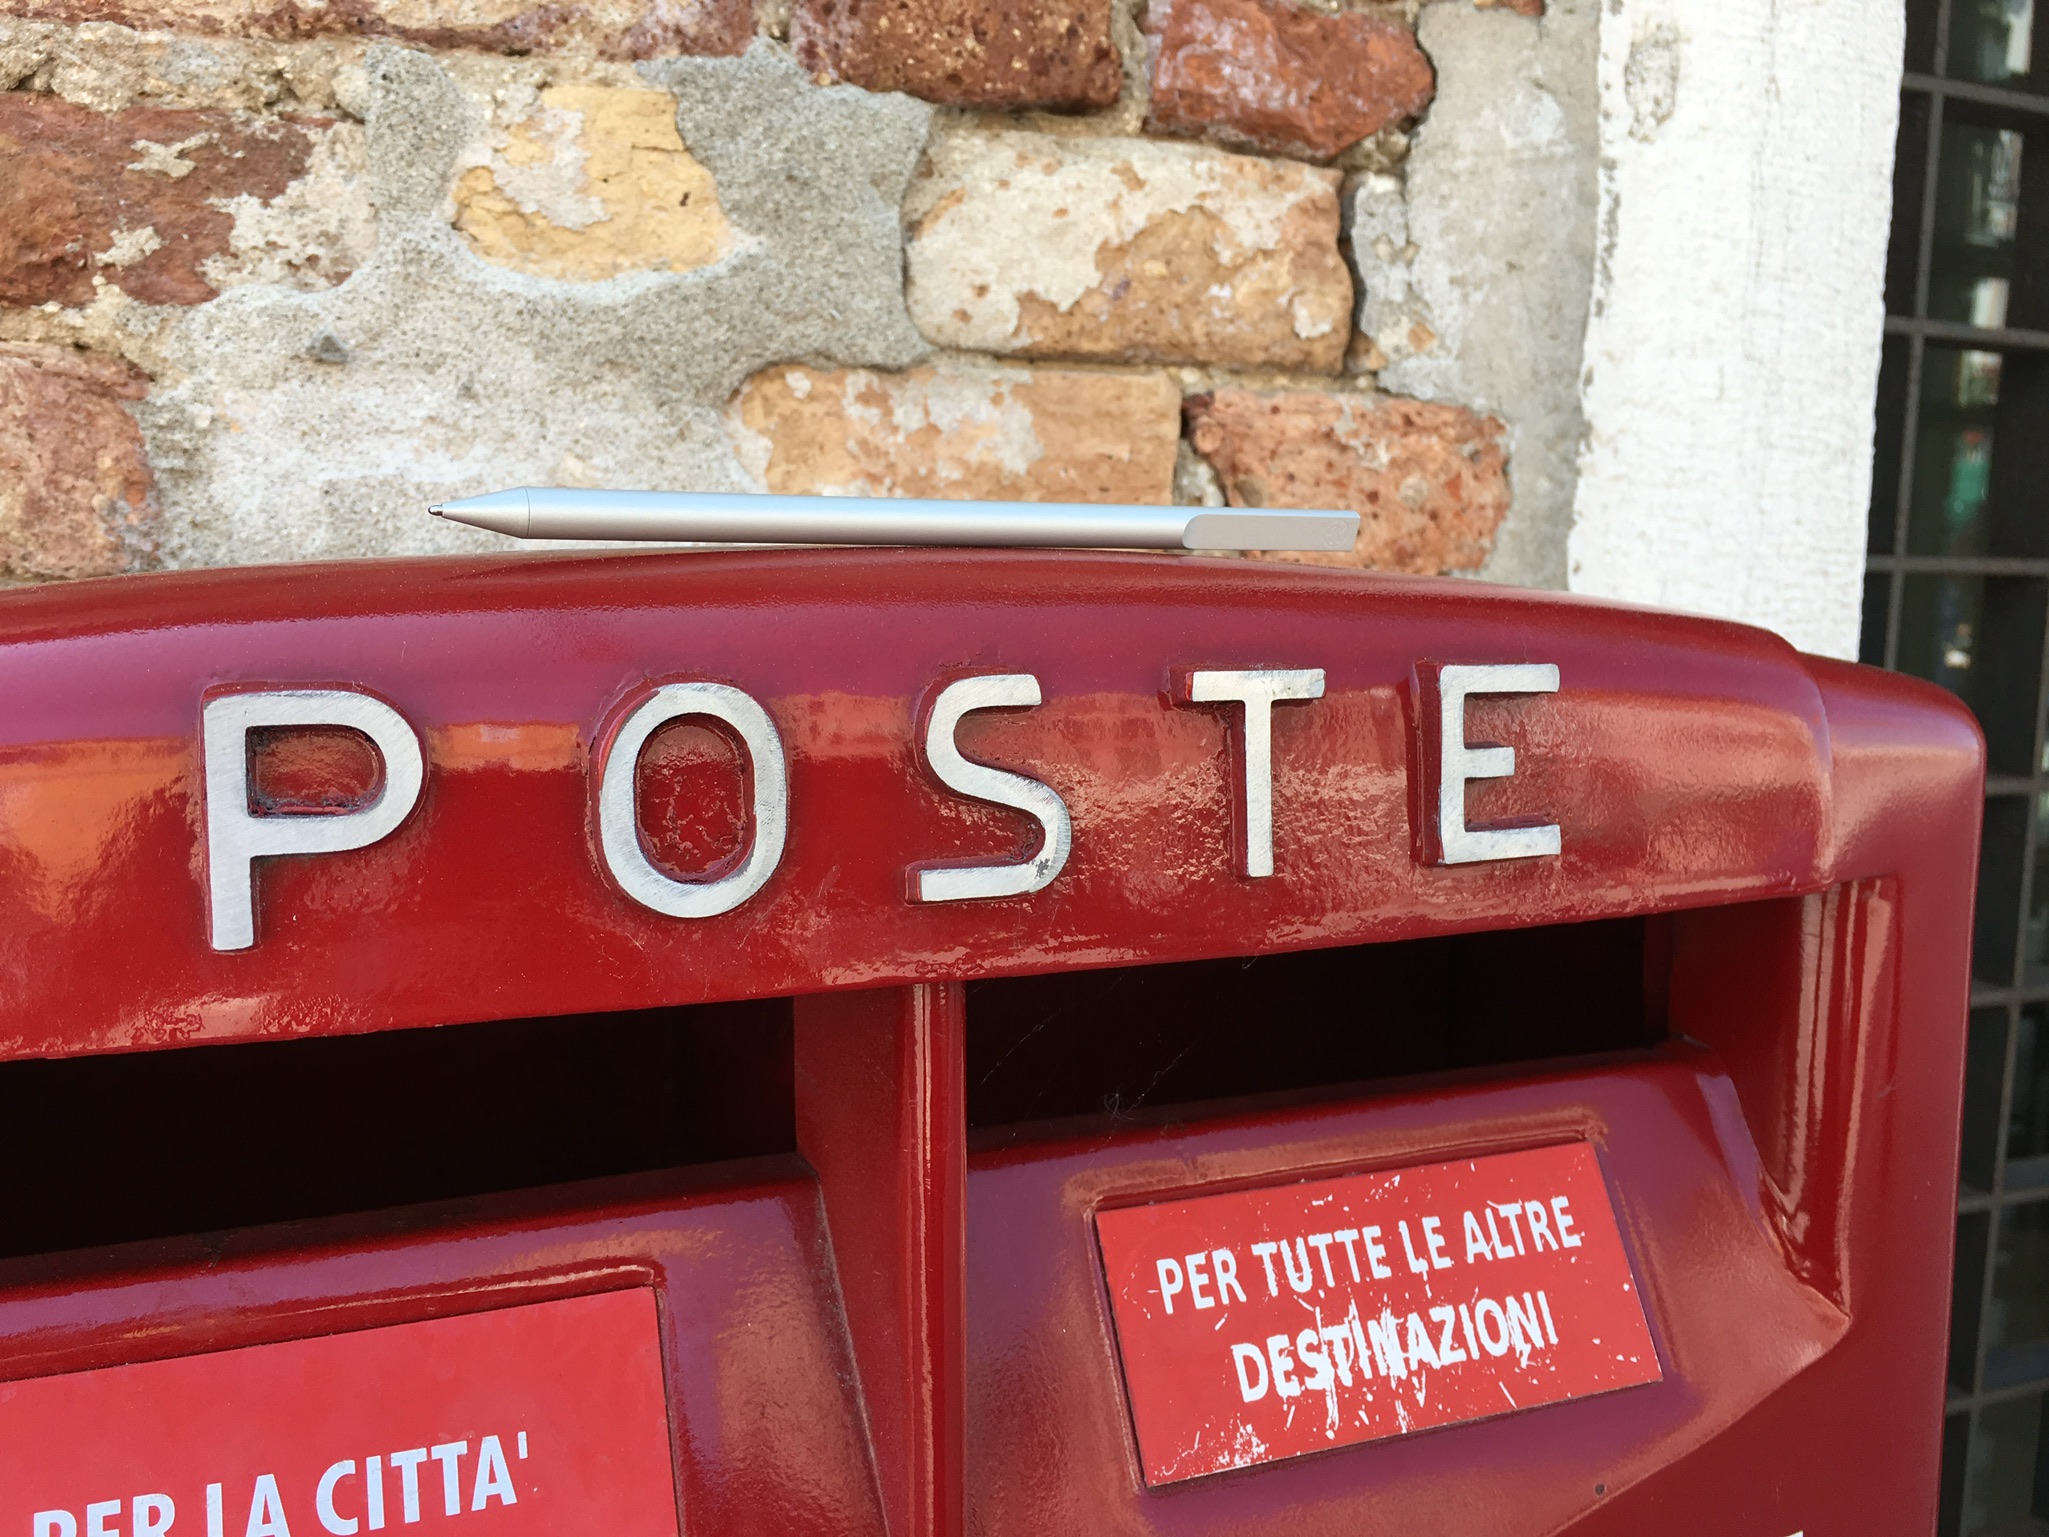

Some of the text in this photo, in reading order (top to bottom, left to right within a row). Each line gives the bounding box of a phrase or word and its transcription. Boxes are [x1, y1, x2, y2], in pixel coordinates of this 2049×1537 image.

[202, 662, 1562, 953] POSTE
[1155, 1195, 1583, 1315] PER TUTTE LE ALTRE
[1231, 1291, 1559, 1402] DESTINAZIONI
[315, 1431, 528, 1536] CITTA'
